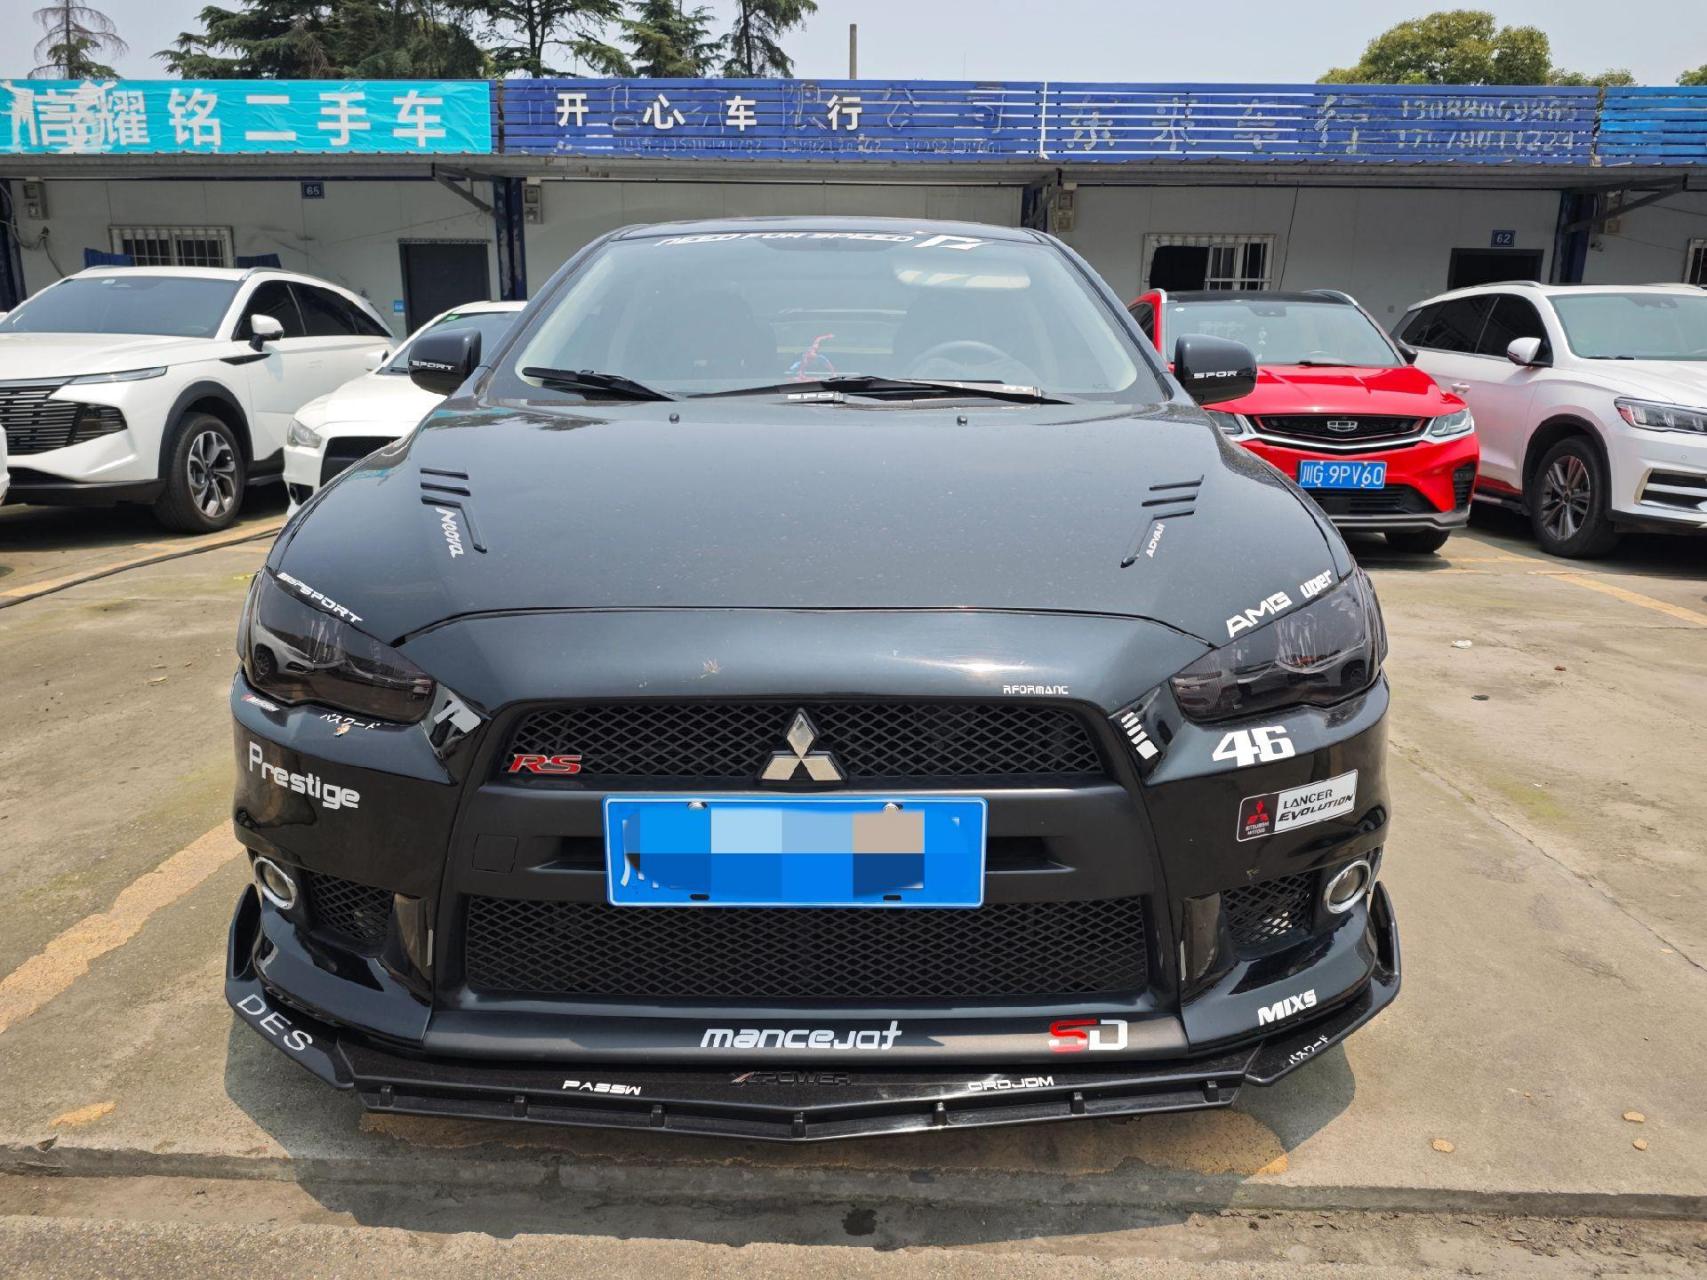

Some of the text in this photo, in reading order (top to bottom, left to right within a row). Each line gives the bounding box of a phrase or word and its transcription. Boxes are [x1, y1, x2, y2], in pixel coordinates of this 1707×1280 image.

[556, 93, 862, 131] 开心车行
[1497, 233, 1511, 244] 62
[412, 360, 456, 371] SPORT
[1193, 370, 1238, 379] SPOR
[1146, 523, 1165, 558] ADVAN
[1226, 592, 1293, 638] AMG
[1212, 726, 1295, 767] 46
[249, 741, 360, 810] Prestige
[508, 754, 582, 774] RS
[1278, 793, 1354, 822] EVOLUTION
[1284, 789, 1333, 809] LANCER
[236, 994, 313, 1051] DES
[562, 1080, 642, 1096] PASSW
